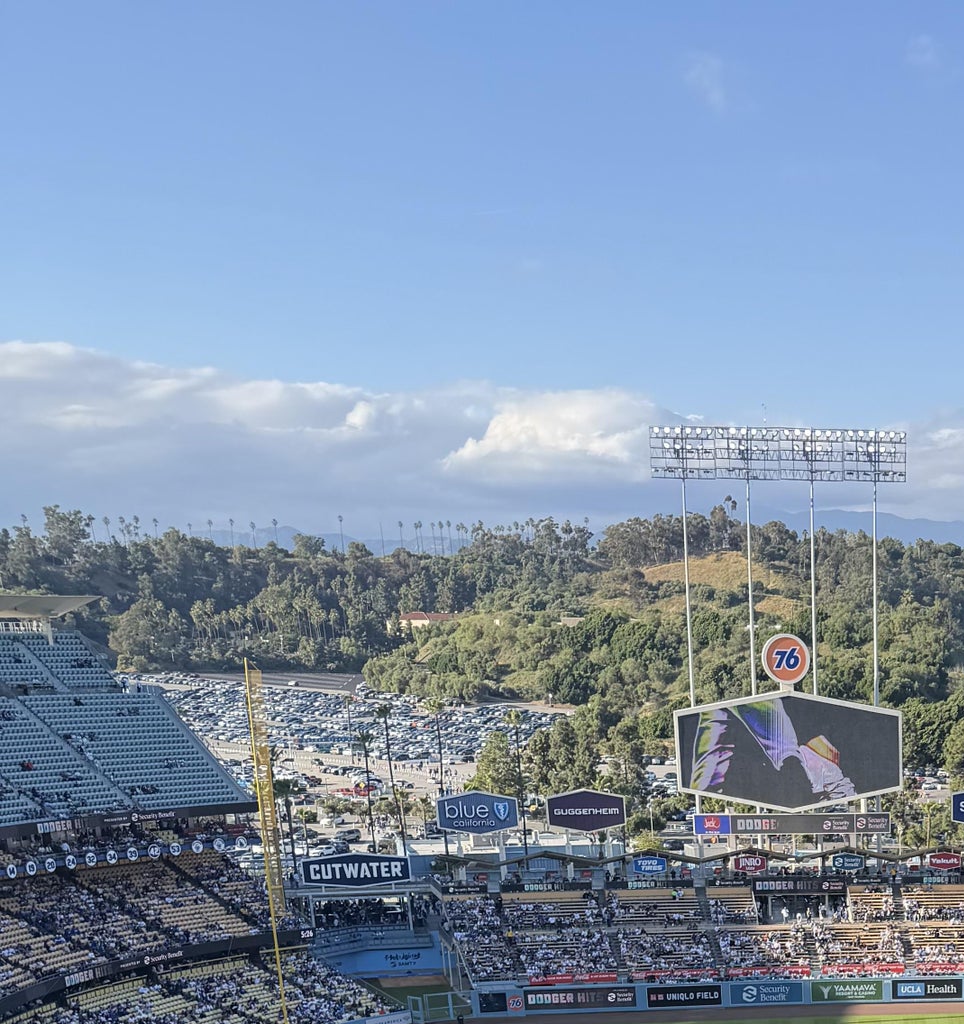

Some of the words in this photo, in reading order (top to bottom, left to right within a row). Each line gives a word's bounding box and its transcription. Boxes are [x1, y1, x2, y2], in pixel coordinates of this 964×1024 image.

[772, 646, 801, 670] 76
[445, 801, 489, 819] blue
[554, 808, 620, 816] GUGGENHEIM
[453, 819, 496, 827] california
[87, 855, 95, 863] 32
[108, 853, 116, 861] 34
[67, 858, 75, 866] 24
[739, 858, 761, 867] JINRO
[309, 862, 403, 880] CUTWATER
[756, 881, 794, 890] DODGER
[64, 970, 94, 987] DODGER
[760, 985, 790, 994] Security
[927, 984, 957, 993] Health
[527, 993, 574, 1004] DODGER
[667, 992, 694, 1001] UNIQLO
[760, 993, 786, 1001] Benefit
[509, 998, 522, 1008] 76
